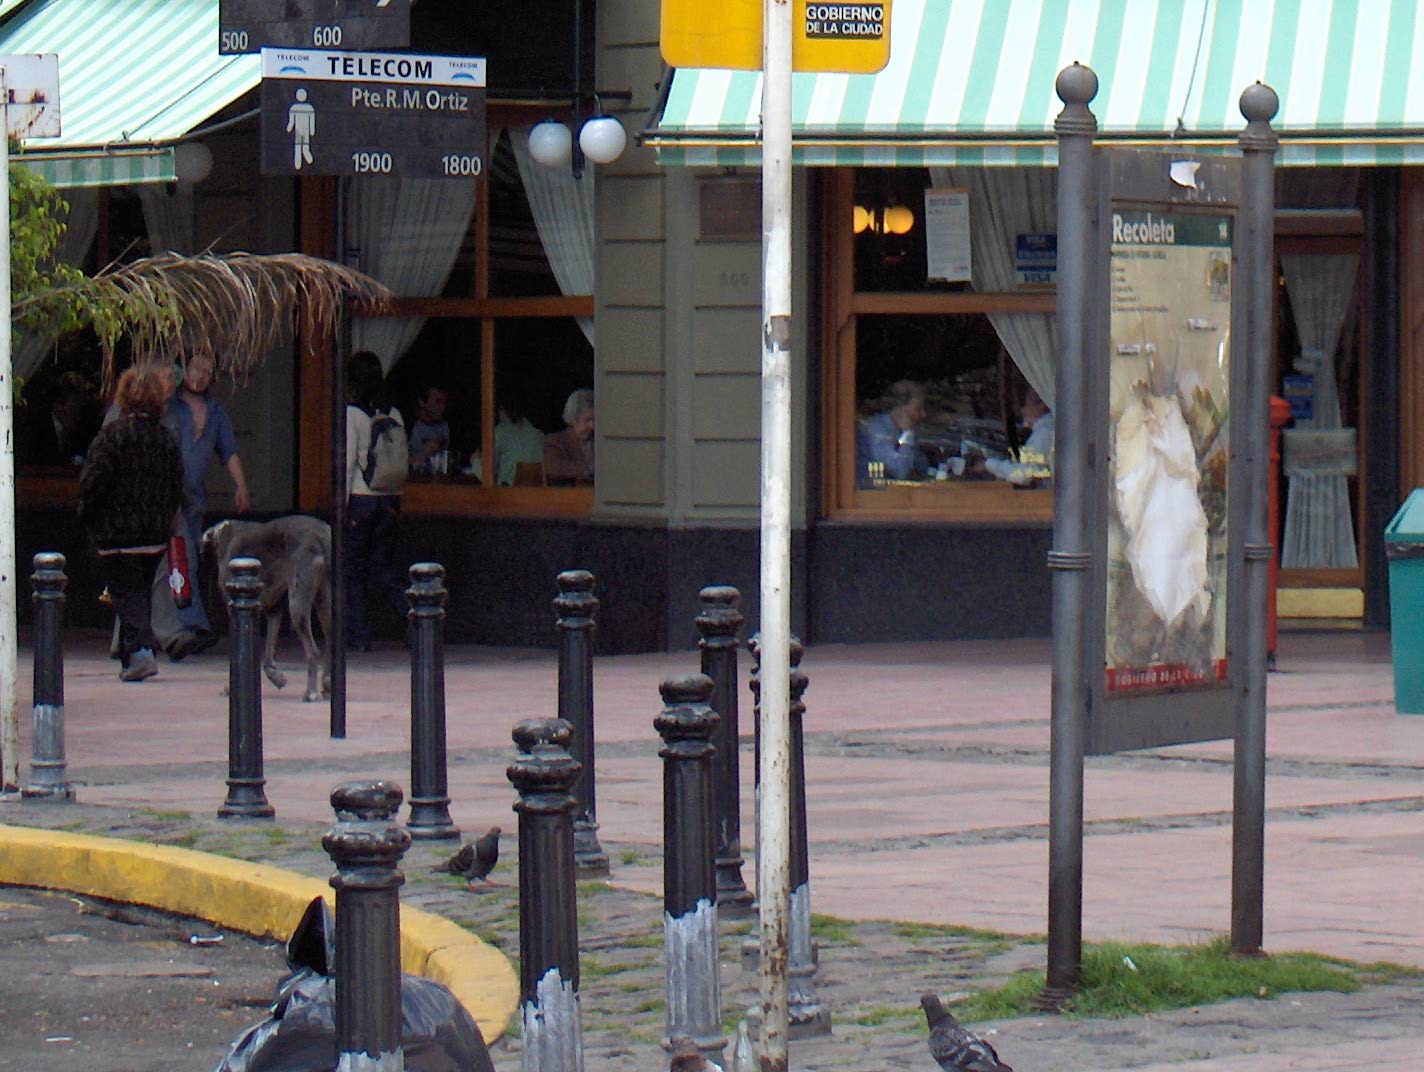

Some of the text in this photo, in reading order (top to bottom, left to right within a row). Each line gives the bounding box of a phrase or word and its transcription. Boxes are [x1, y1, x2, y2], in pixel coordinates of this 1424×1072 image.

[806, 6, 884, 22] GOBIERNO
[222, 26, 342, 51] 500 600
[806, 22, 883, 35] DE LA CIUDAD
[327, 56, 433, 79] TELECOM
[352, 153, 482, 176] 1900 1800
[1112, 213, 1176, 243] Recoleta
